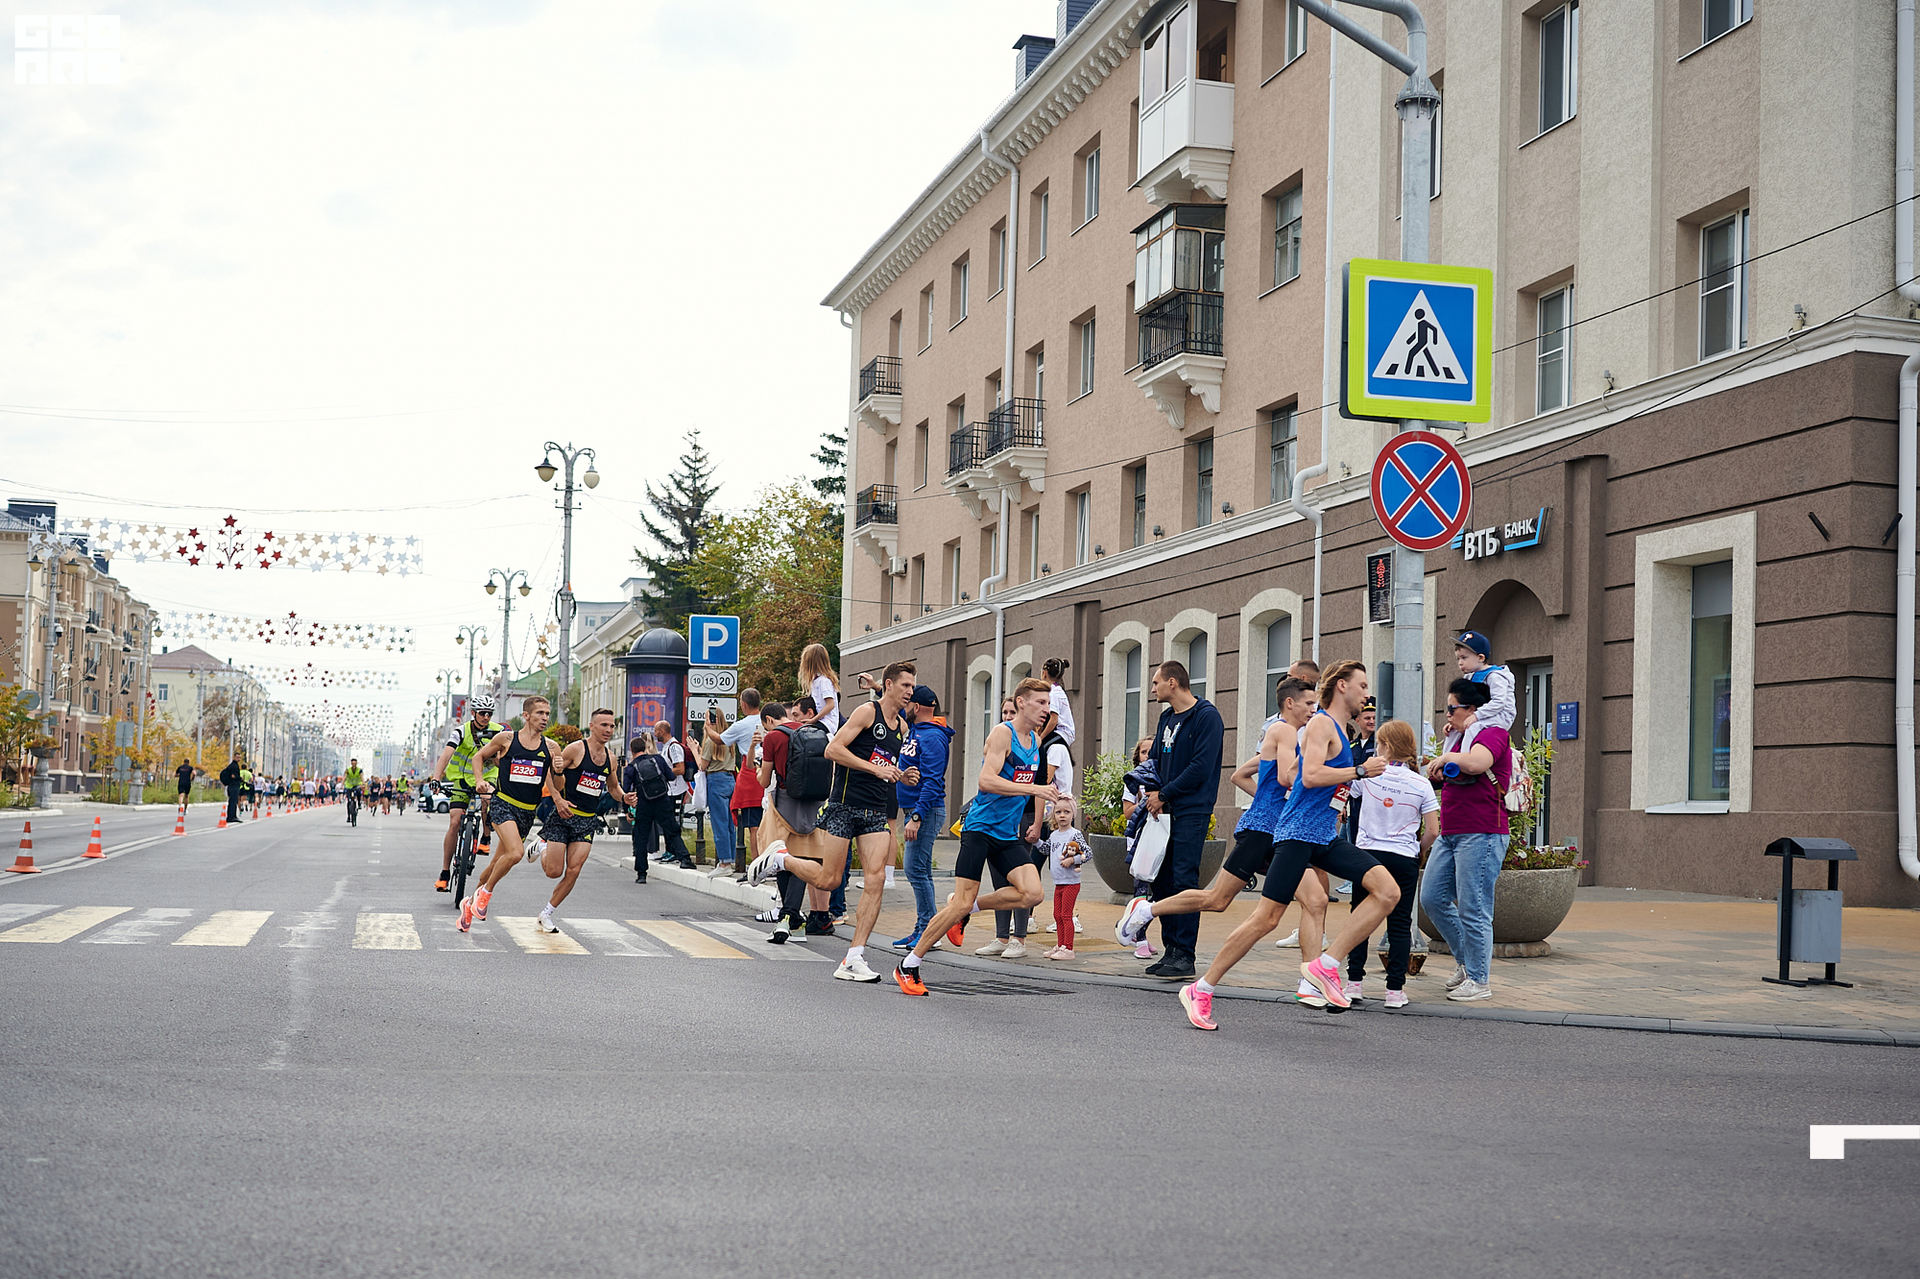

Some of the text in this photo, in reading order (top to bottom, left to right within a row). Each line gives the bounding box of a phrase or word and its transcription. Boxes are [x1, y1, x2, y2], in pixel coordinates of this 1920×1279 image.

[1464, 518, 1536, 560] ВТБ БАНК
[702, 622, 729, 660] P
[705, 677, 714, 685] 15
[719, 677, 731, 686] 20
[632, 685, 667, 694] ВЫБОРЫ
[633, 700, 662, 726] 19
[512, 765, 536, 775] 2326
[580, 777, 601, 789] 2000
[1015, 772, 1034, 783] 2327
